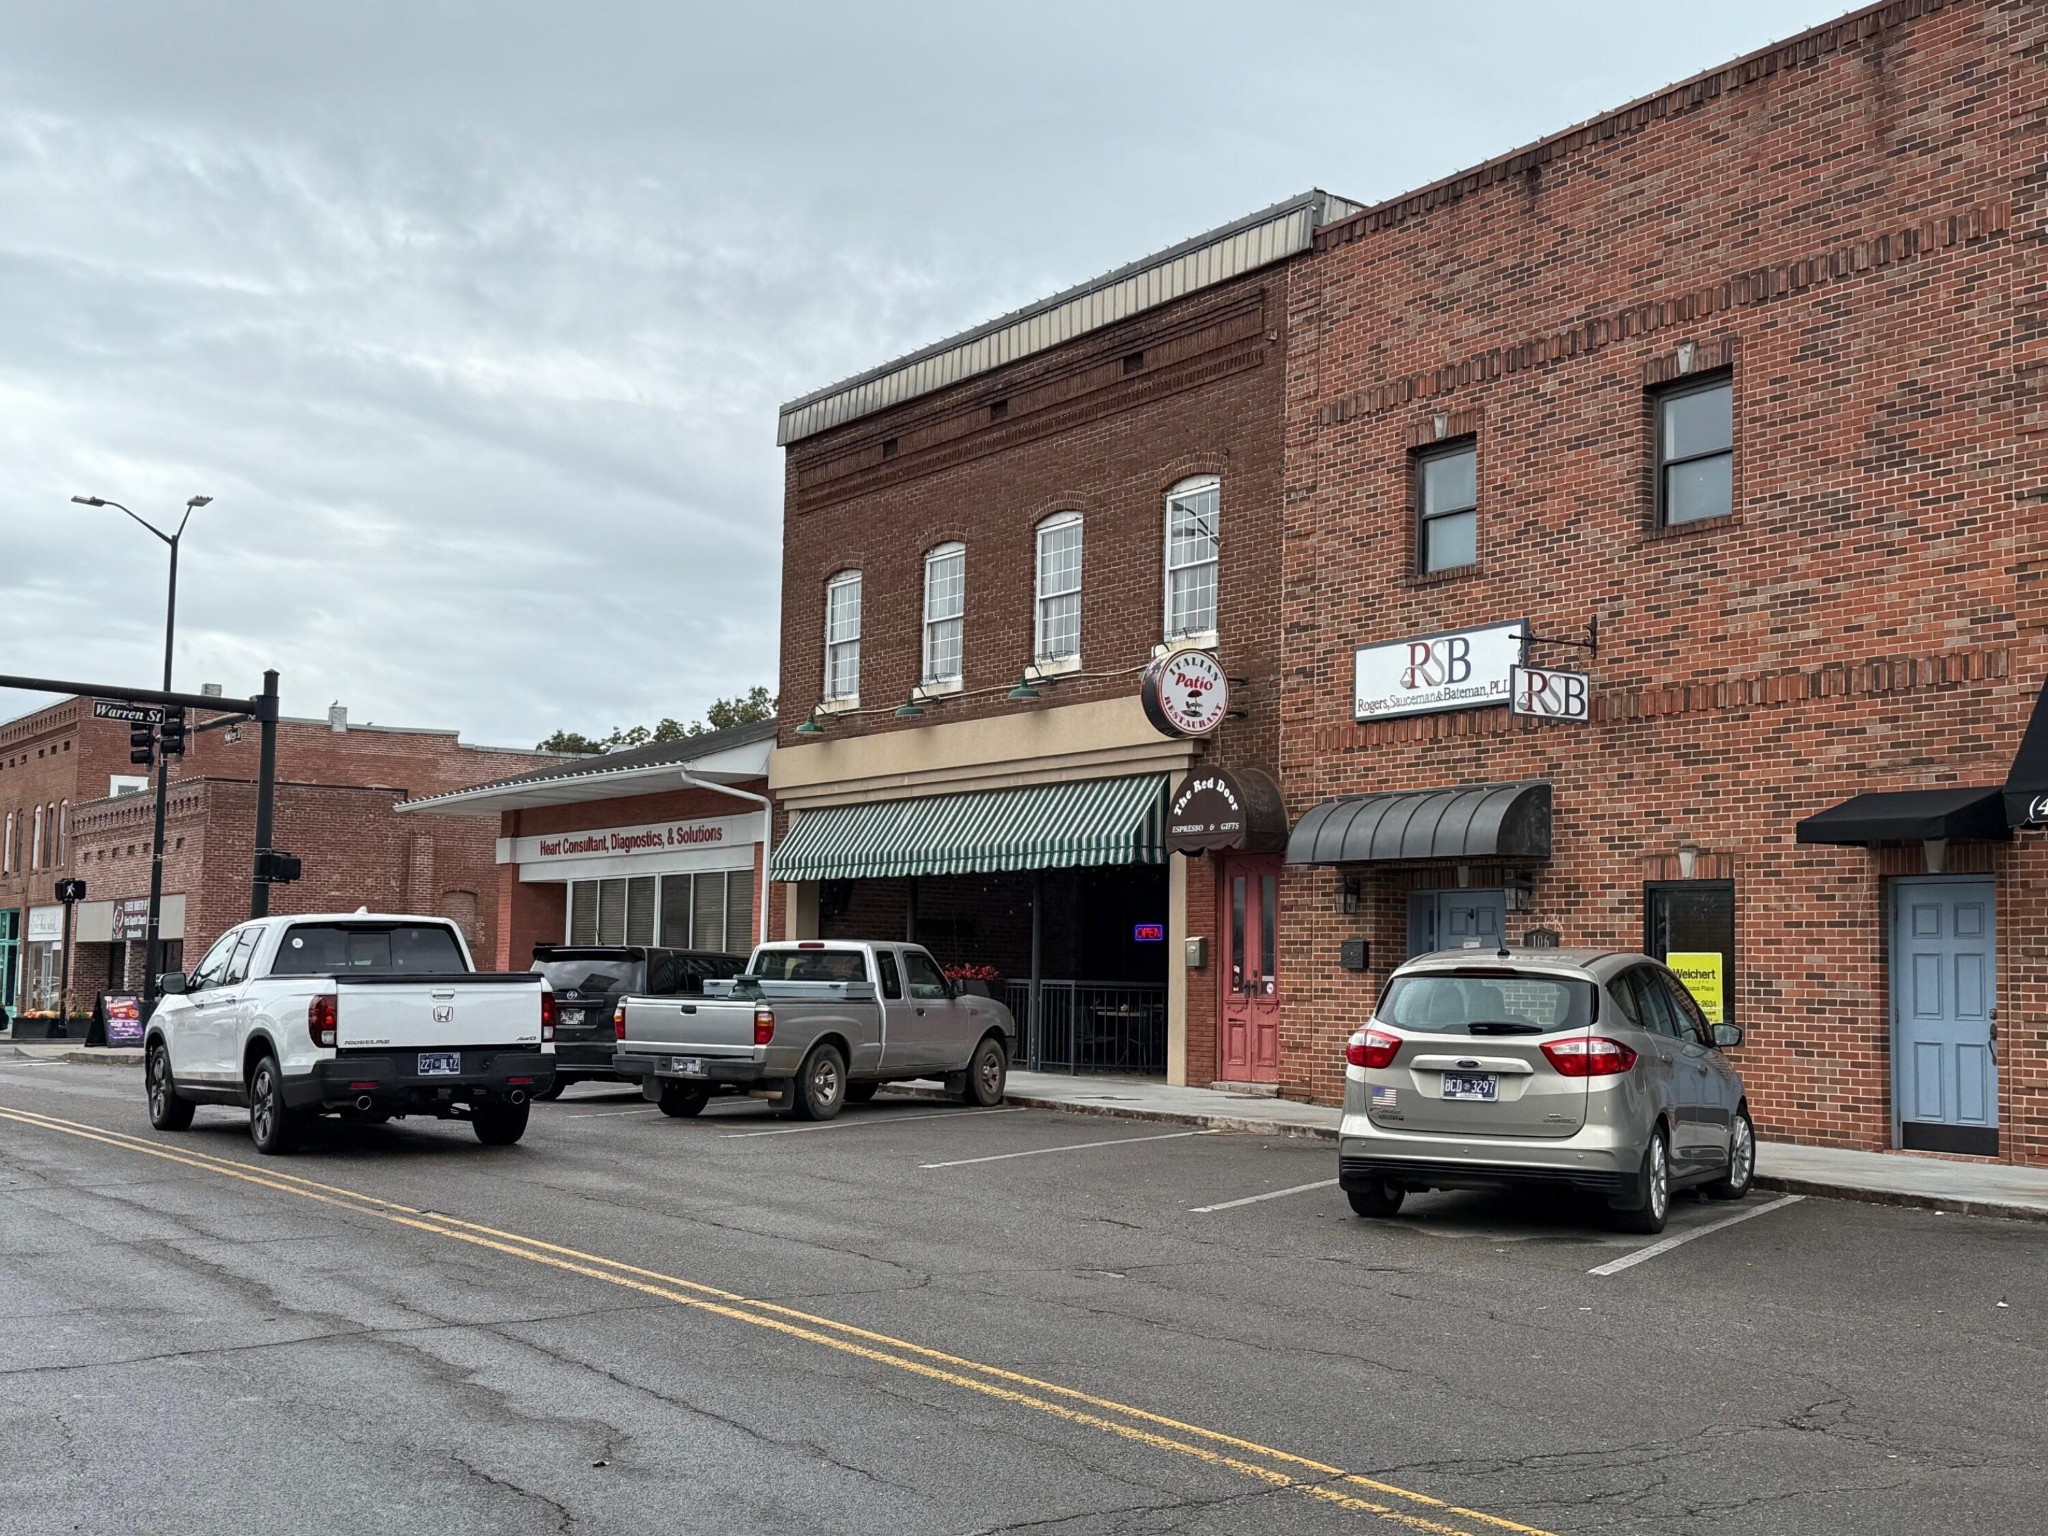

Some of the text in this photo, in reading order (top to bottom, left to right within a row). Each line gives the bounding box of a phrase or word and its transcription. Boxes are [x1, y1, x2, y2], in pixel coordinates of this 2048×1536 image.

[1168, 657, 1221, 681] ITALIAN
[1400, 637, 1472, 690] RSB
[1175, 672, 1213, 691] Patio
[1443, 685, 1490, 701] Bateman,
[1490, 678, 1511, 695] PLL
[1517, 670, 1586, 716] RSB
[96, 704, 162, 722] Warren St
[1164, 696, 1222, 729] RESTAURANT
[1173, 777, 1239, 816] The Red Door
[1171, 822, 1240, 833] ESPRESSO & GIFTS
[540, 825, 722, 856] Heart Consultant, Diagnostics, & Solutions
[1137, 927, 1160, 939] OPEN
[1532, 935, 1550, 948] 106
[1672, 968, 1716, 980] Weichert
[420, 1058, 434, 1070] 227
[1444, 1079, 1495, 1094] BCD 3297
